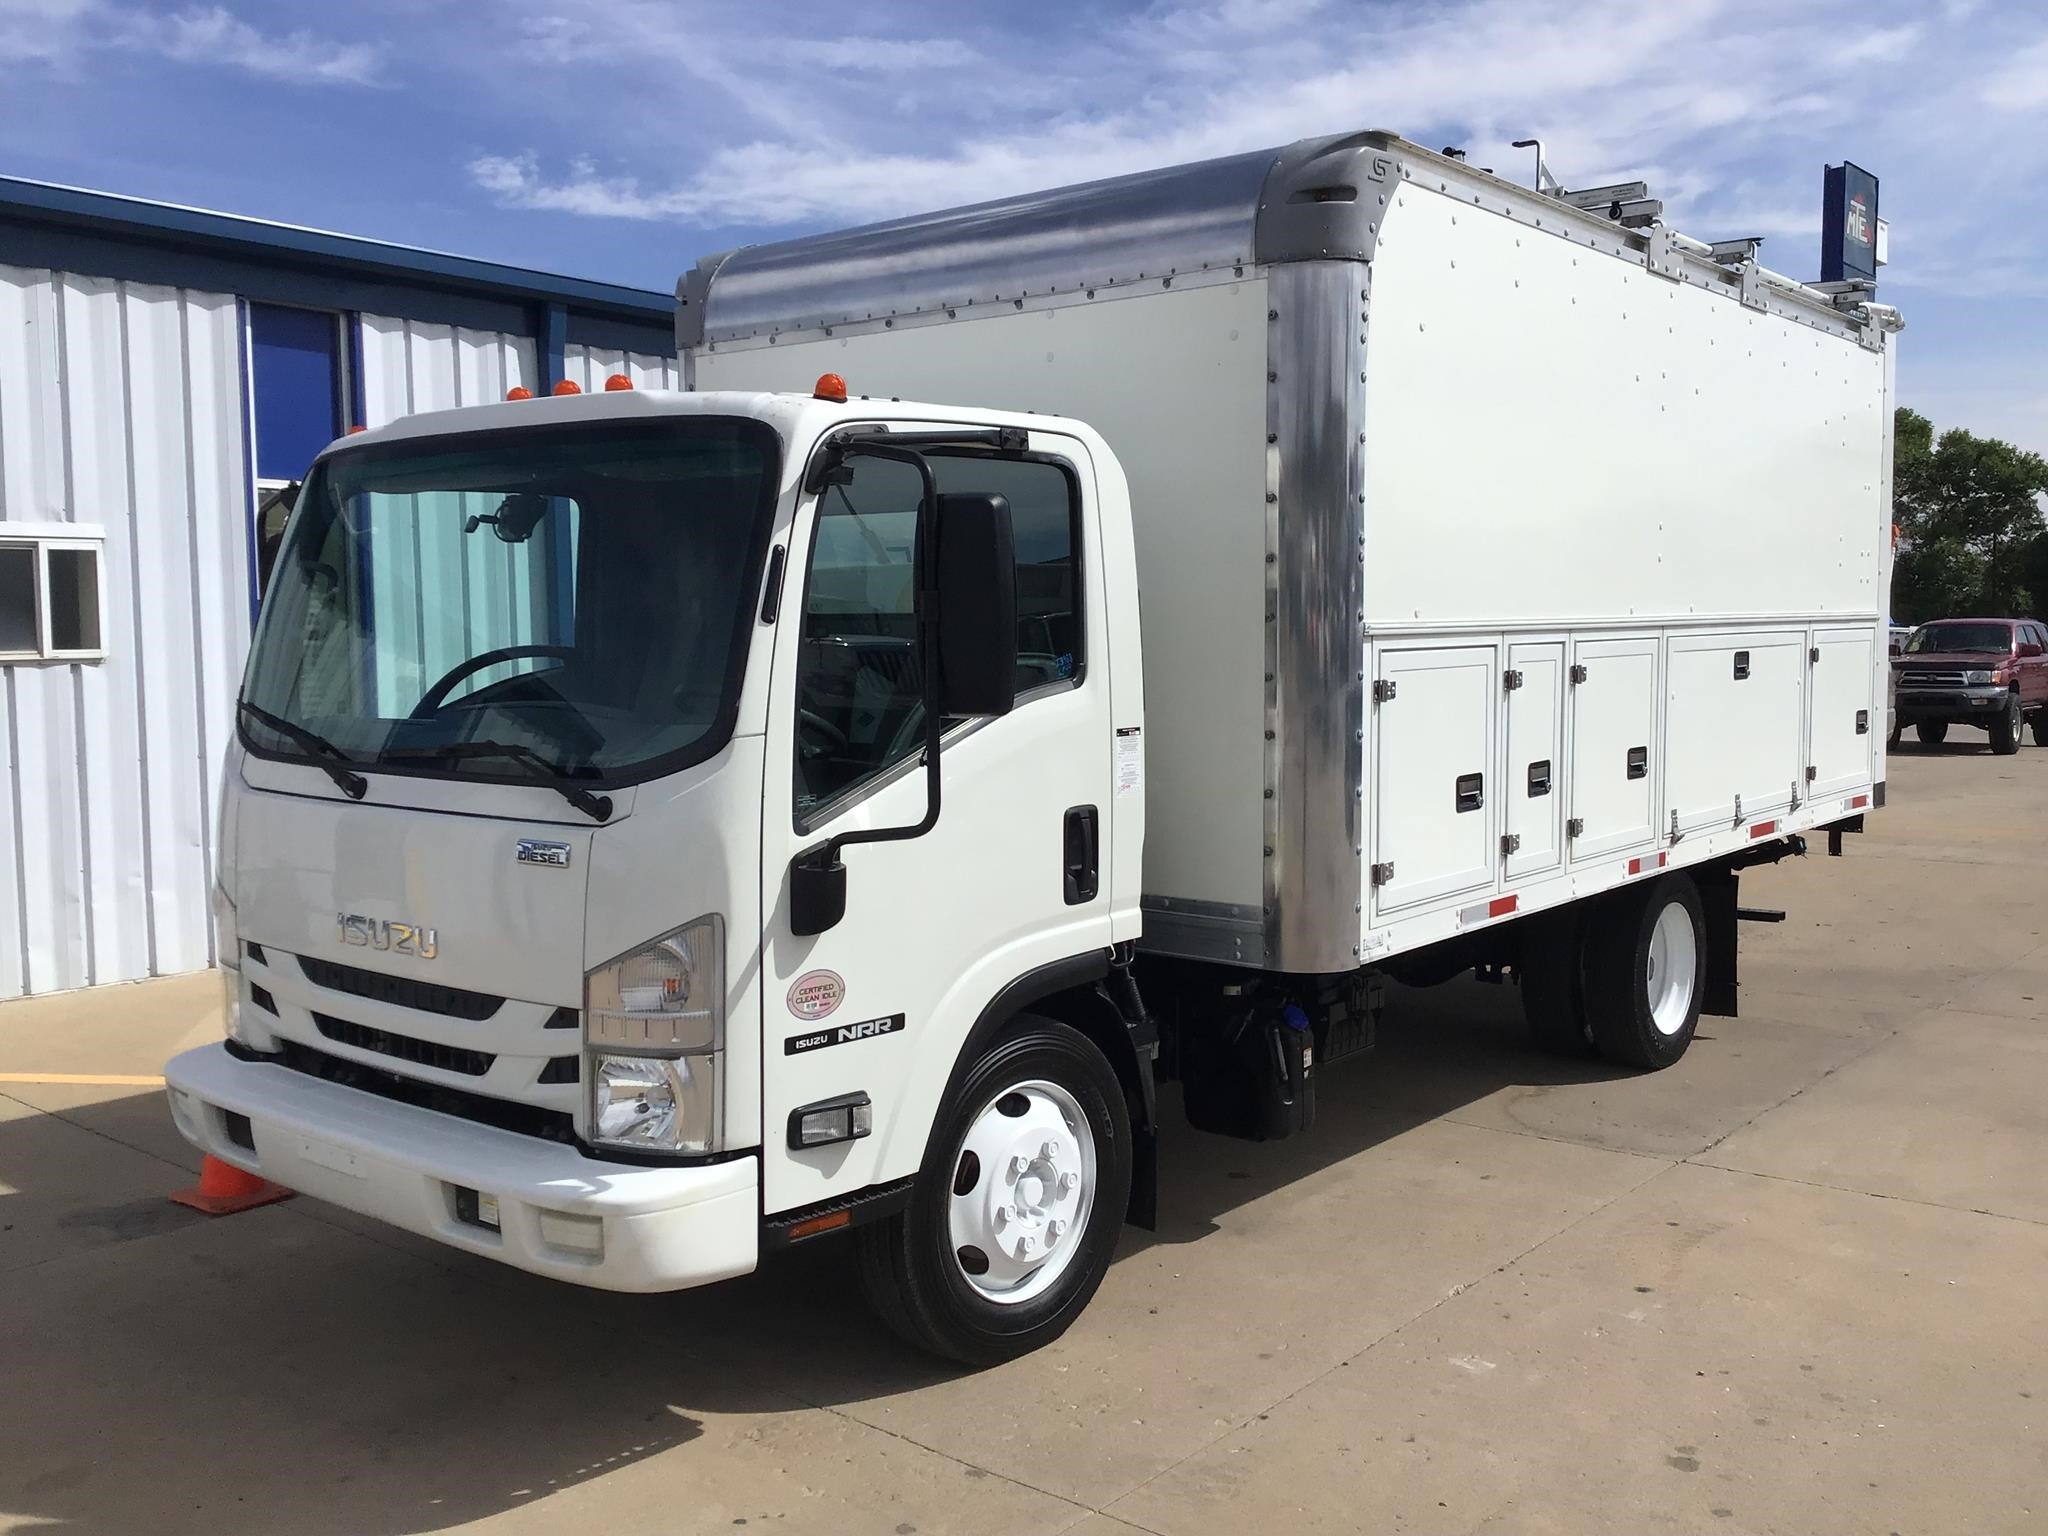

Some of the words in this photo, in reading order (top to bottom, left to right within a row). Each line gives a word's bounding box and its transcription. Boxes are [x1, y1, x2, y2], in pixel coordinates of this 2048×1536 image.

[517, 850, 564, 864] DIESEL
[337, 912, 439, 960] ISUZU
[795, 994, 820, 1004] CLEAN
[822, 990, 838, 999] IDLE
[799, 984, 834, 996] CERTIFIED
[796, 1034, 828, 1049] ISUZU
[838, 1018, 892, 1041] NRR
